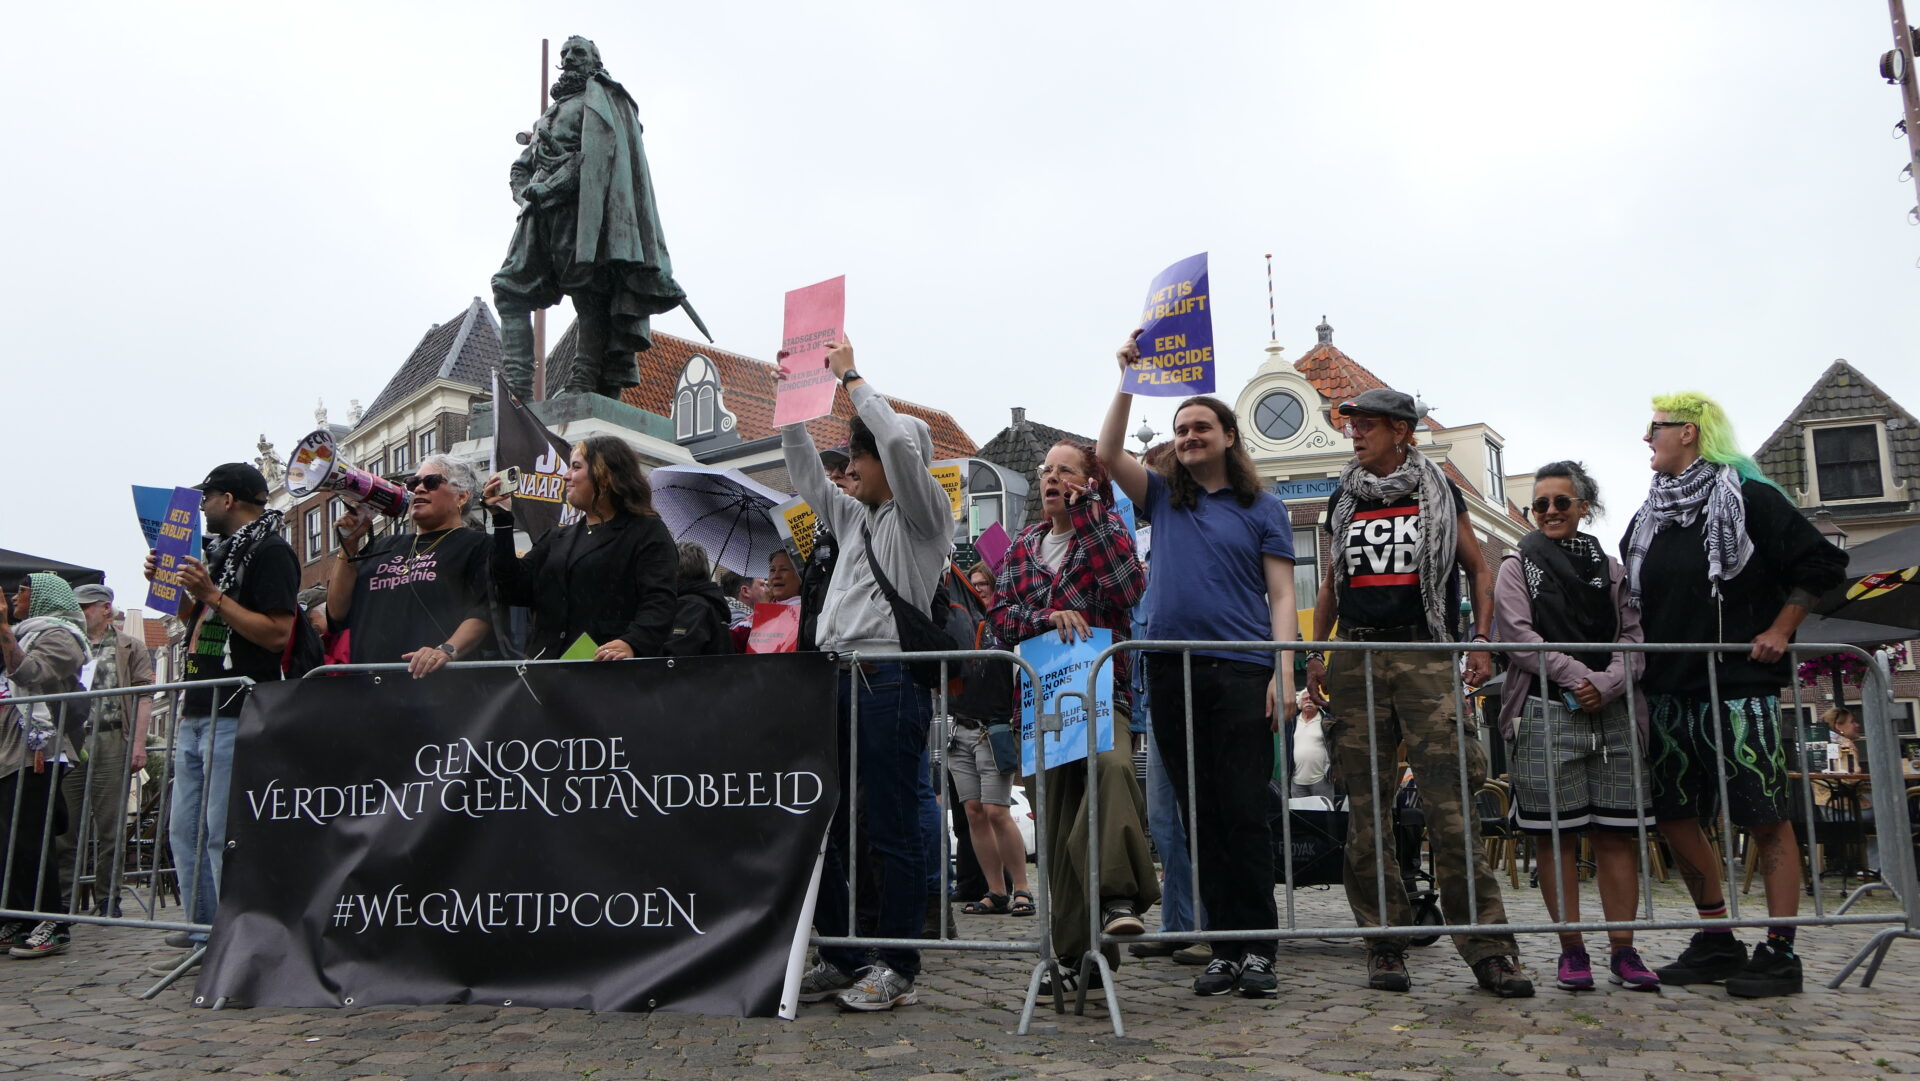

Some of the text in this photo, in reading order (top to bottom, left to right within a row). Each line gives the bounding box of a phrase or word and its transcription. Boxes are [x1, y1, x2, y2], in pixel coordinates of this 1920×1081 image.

[1150, 280, 1193, 305] HET IS
[1154, 295, 1207, 321] BLIJFT
[1155, 334, 1187, 352] EEN
[1130, 347, 1213, 370] GENOCIDE
[1137, 366, 1204, 385] PLEGER
[170, 509, 190, 524] HET IS
[791, 520, 804, 530] HET
[797, 533, 811, 542] VAN
[1346, 515, 1419, 547] FCK
[162, 553, 175, 568] EEN
[376, 560, 437, 576] Dag van
[391, 555, 404, 564] 3
[1345, 543, 1419, 575] FVD
[154, 568, 182, 586] ENOCID
[369, 568, 437, 591] Empathie
[151, 582, 176, 600] PLEGER
[1023, 676, 1043, 690] NIT
[1045, 663, 1081, 681] PRATEN
[1023, 690, 1033, 699] JE
[1053, 675, 1072, 688] ONS
[1024, 691, 1055, 708] WGT
[1023, 722, 1035, 732] HE
[415, 737, 630, 781] GENOCIDE
[245, 770, 823, 824] VERDIENT GEEN STANDBEELD
[333, 884, 706, 934] #WEGMETJPCOEN
